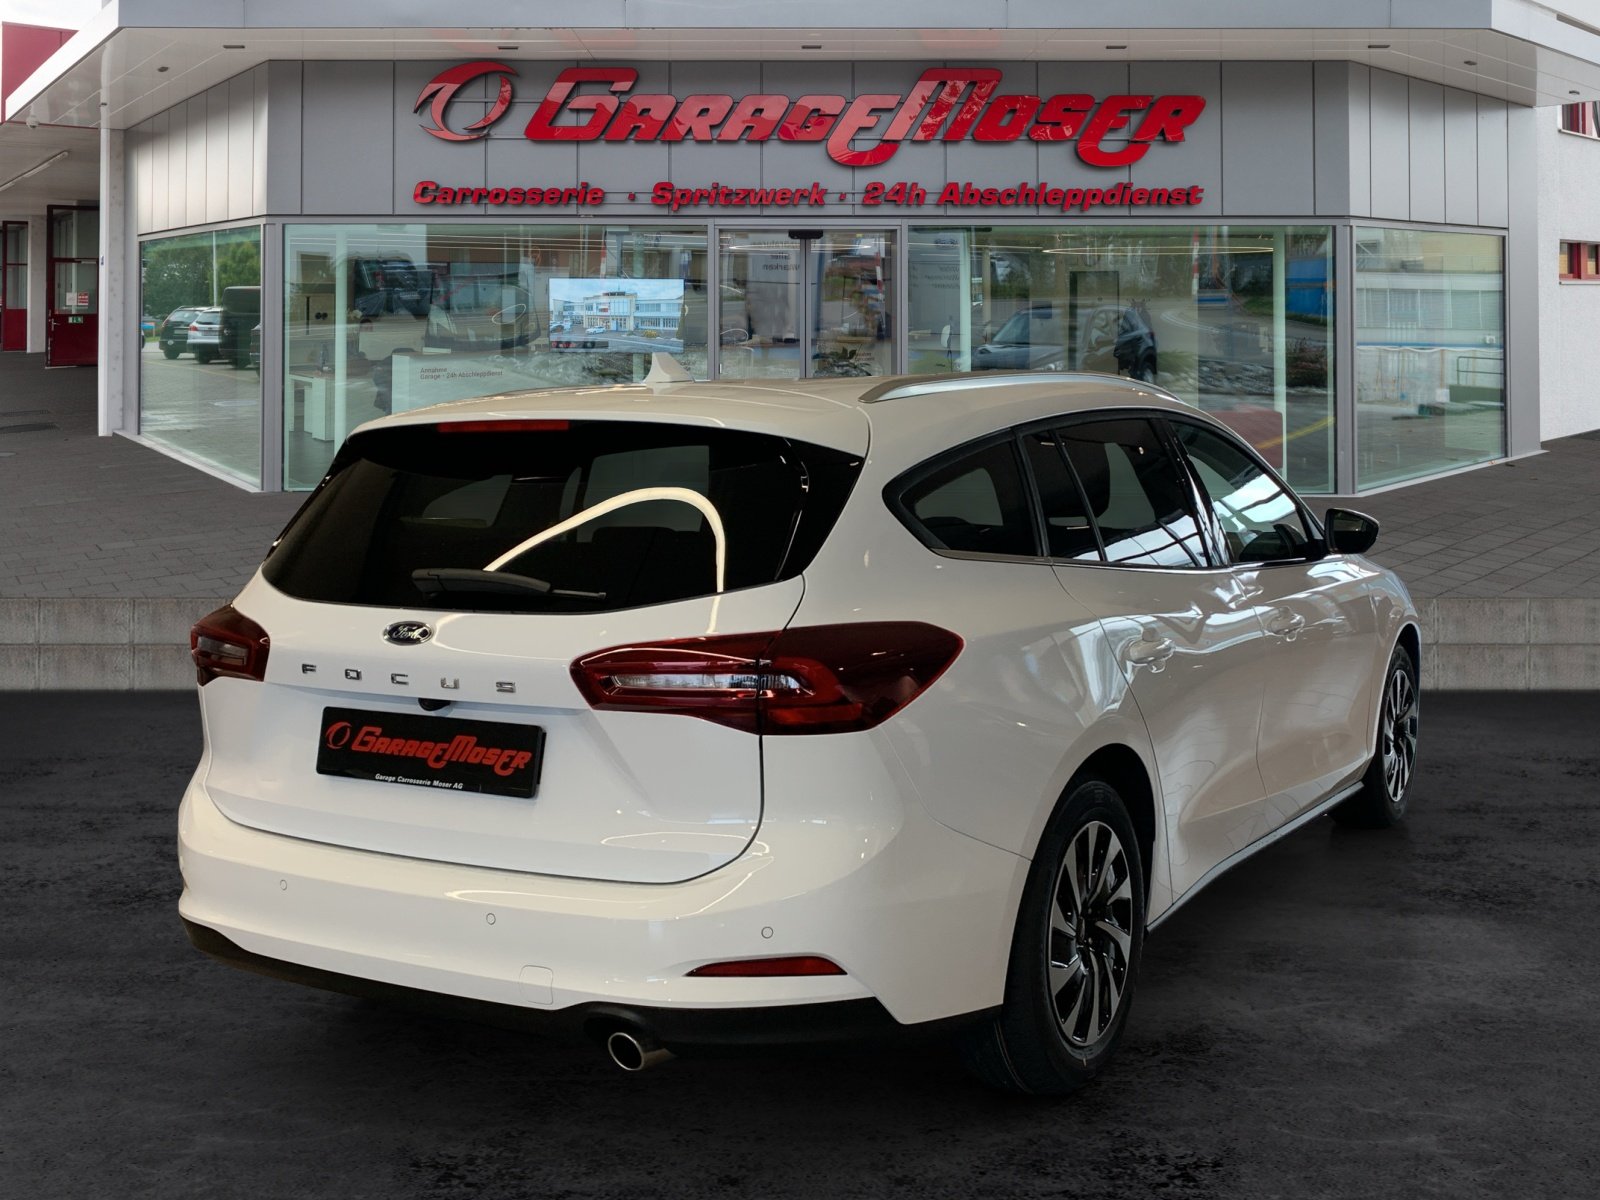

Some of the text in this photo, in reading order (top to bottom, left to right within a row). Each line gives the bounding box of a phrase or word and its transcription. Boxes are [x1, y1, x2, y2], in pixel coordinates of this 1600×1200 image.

[413, 180, 1204, 211] Carrosserie Spritzwerk 24h Abschleppdienst
[458, 370, 503, 378] Abschleppdienst
[392, 625, 429, 640] Ford
[302, 663, 516, 693] FOCUS
[375, 773, 396, 782] Garage
[397, 776, 431, 786] Carrosserie
[432, 780, 452, 788] Moser
